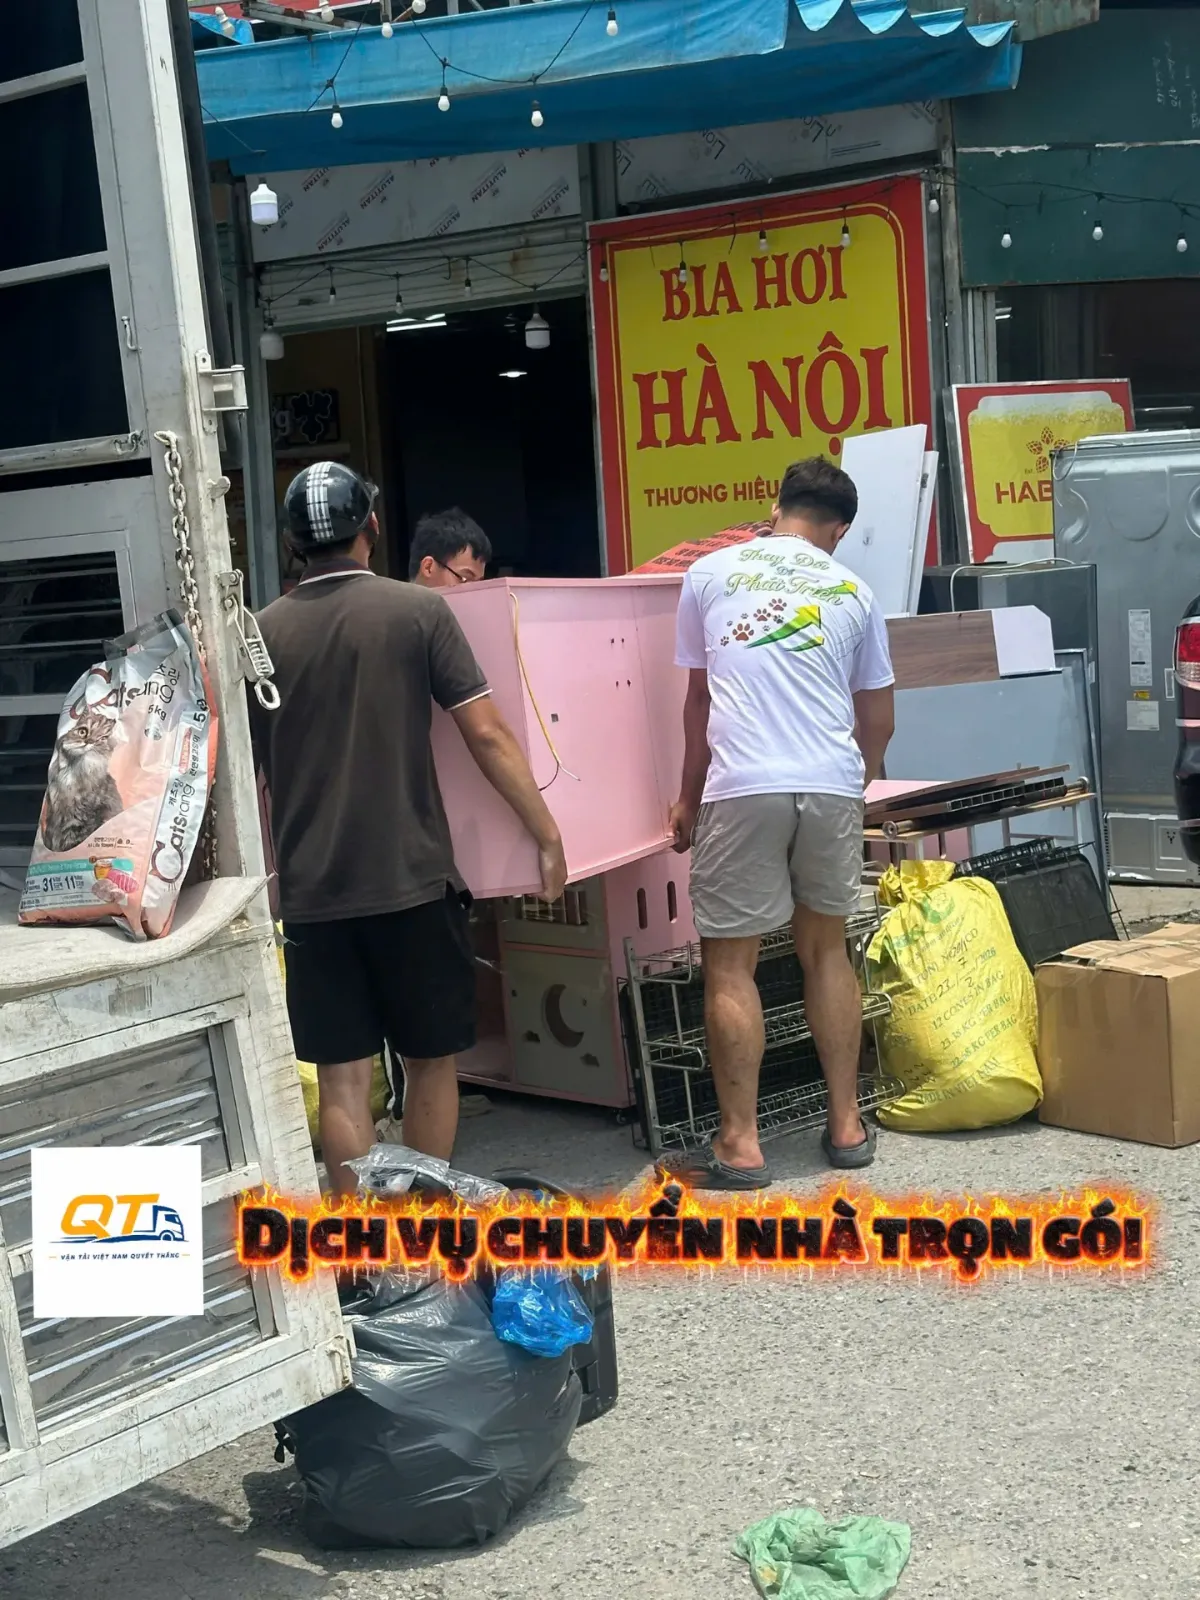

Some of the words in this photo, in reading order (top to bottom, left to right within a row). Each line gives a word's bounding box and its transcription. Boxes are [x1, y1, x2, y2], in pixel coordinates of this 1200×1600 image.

[303, 167, 330, 192] UTITAN
[360, 174, 395, 210] ALUTITAN
[471, 166, 507, 203] ALUTITAN
[532, 183, 570, 220] ALUTITAN
[317, 216, 350, 251] ALUTITAN
[660, 261, 743, 322] BIA
[751, 244, 847, 311] HƠI
[633, 343, 741, 450] HÀ
[748, 331, 892, 455] NỘI
[644, 484, 728, 507] THƯƠNG
[733, 474, 779, 505] HIỆU
[149, 783, 195, 884] Catsrang
[984, 970, 1004, 989] BAG
[993, 991, 1011, 1010] BAG
[971, 1035, 986, 1052] KG
[1000, 1013, 1017, 1032] BAG
